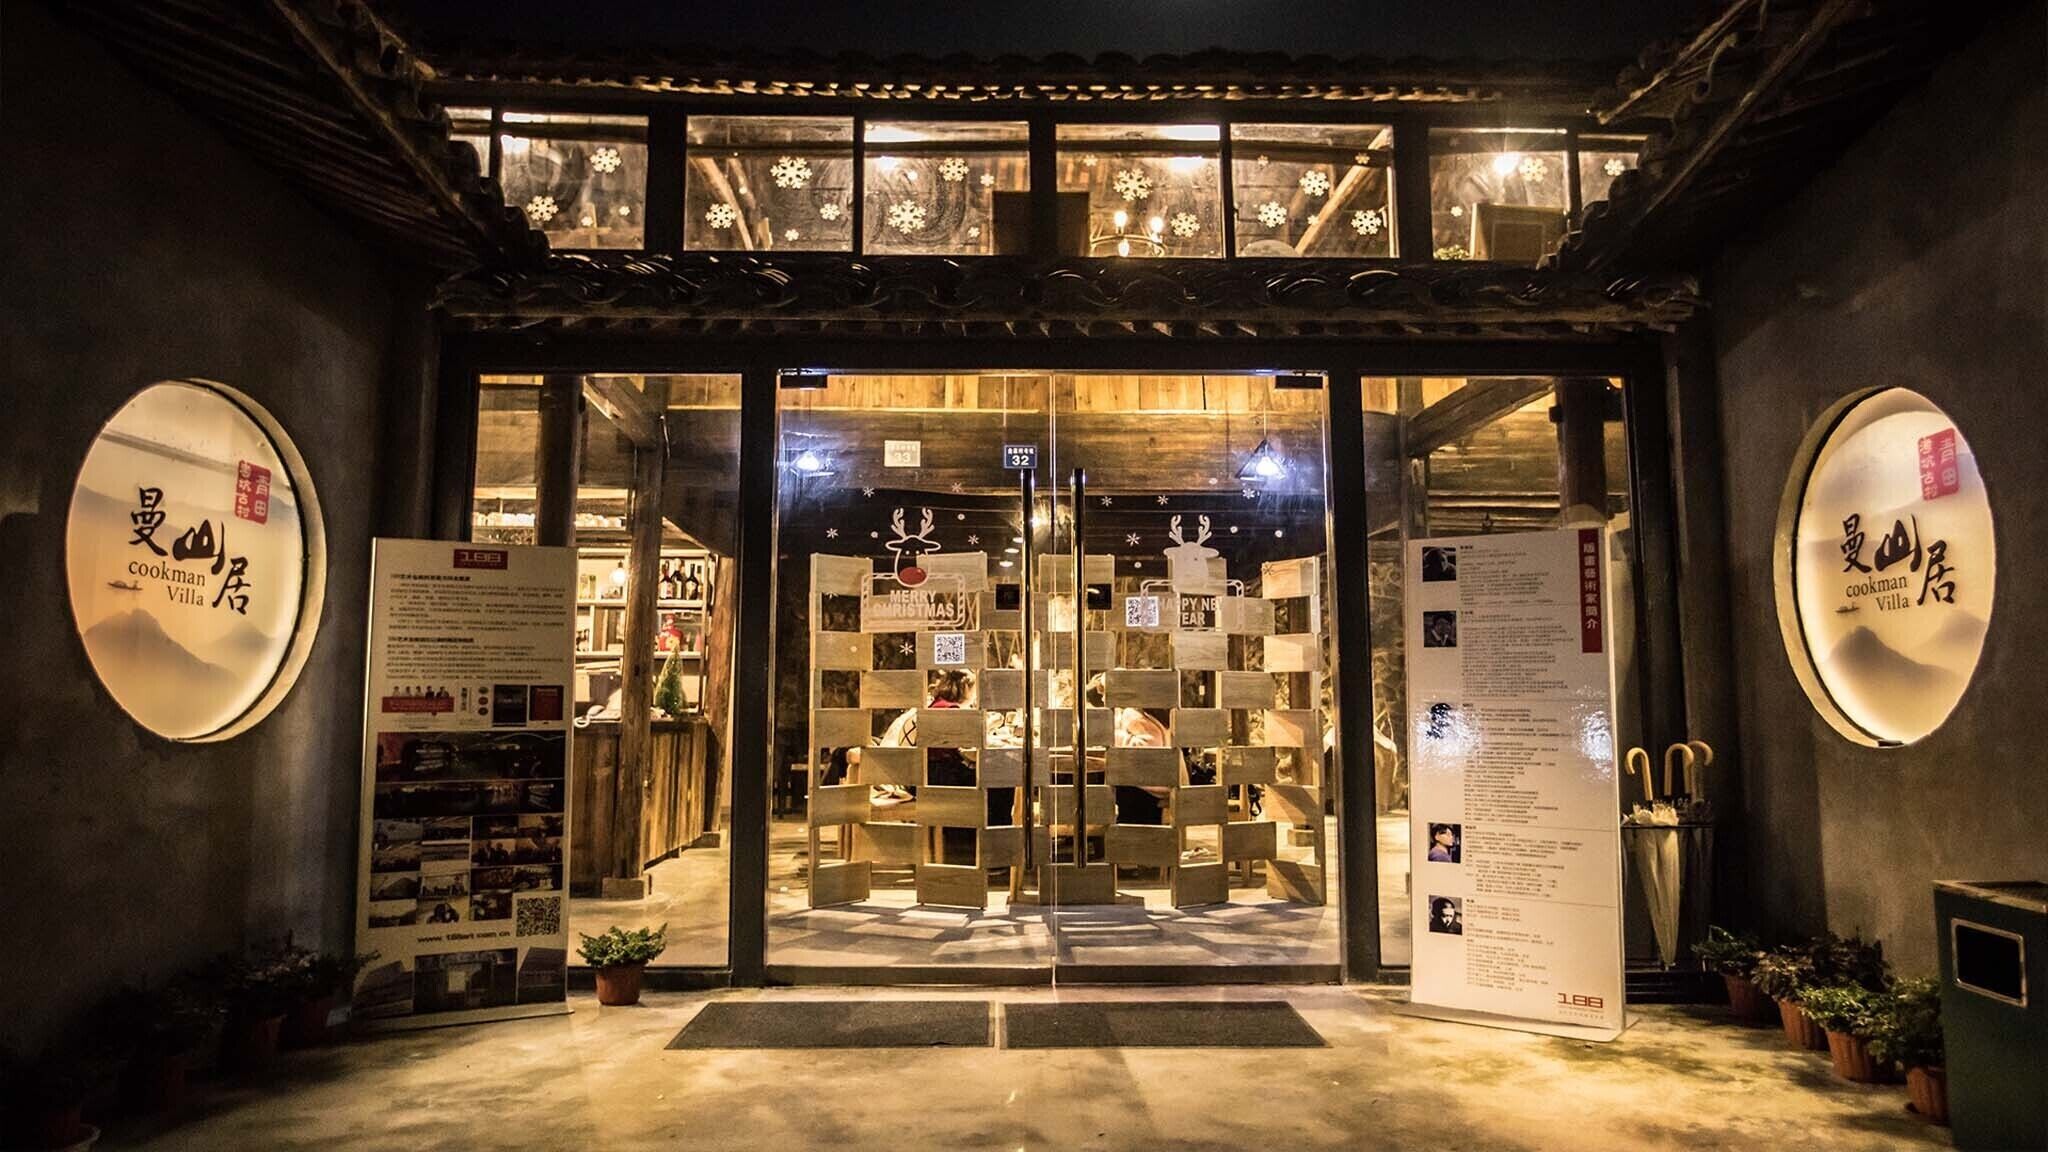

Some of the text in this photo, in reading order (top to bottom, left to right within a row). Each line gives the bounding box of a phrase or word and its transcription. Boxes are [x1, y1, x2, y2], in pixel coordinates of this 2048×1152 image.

[1012, 454, 1030, 466] 32
[128, 486, 251, 616] 曼山居
[460, 552, 501, 563] 188
[1840, 512, 1956, 607] 曼山居
[128, 560, 206, 587] cookman
[1846, 575, 1908, 598] cookman
[167, 585, 204, 606] Villa
[889, 590, 937, 603] MERRY
[1875, 593, 1909, 611] Villa
[873, 602, 955, 618] CHRISTMAS
[1174, 611, 1206, 625] EAR
[1557, 992, 1604, 1009] 188
